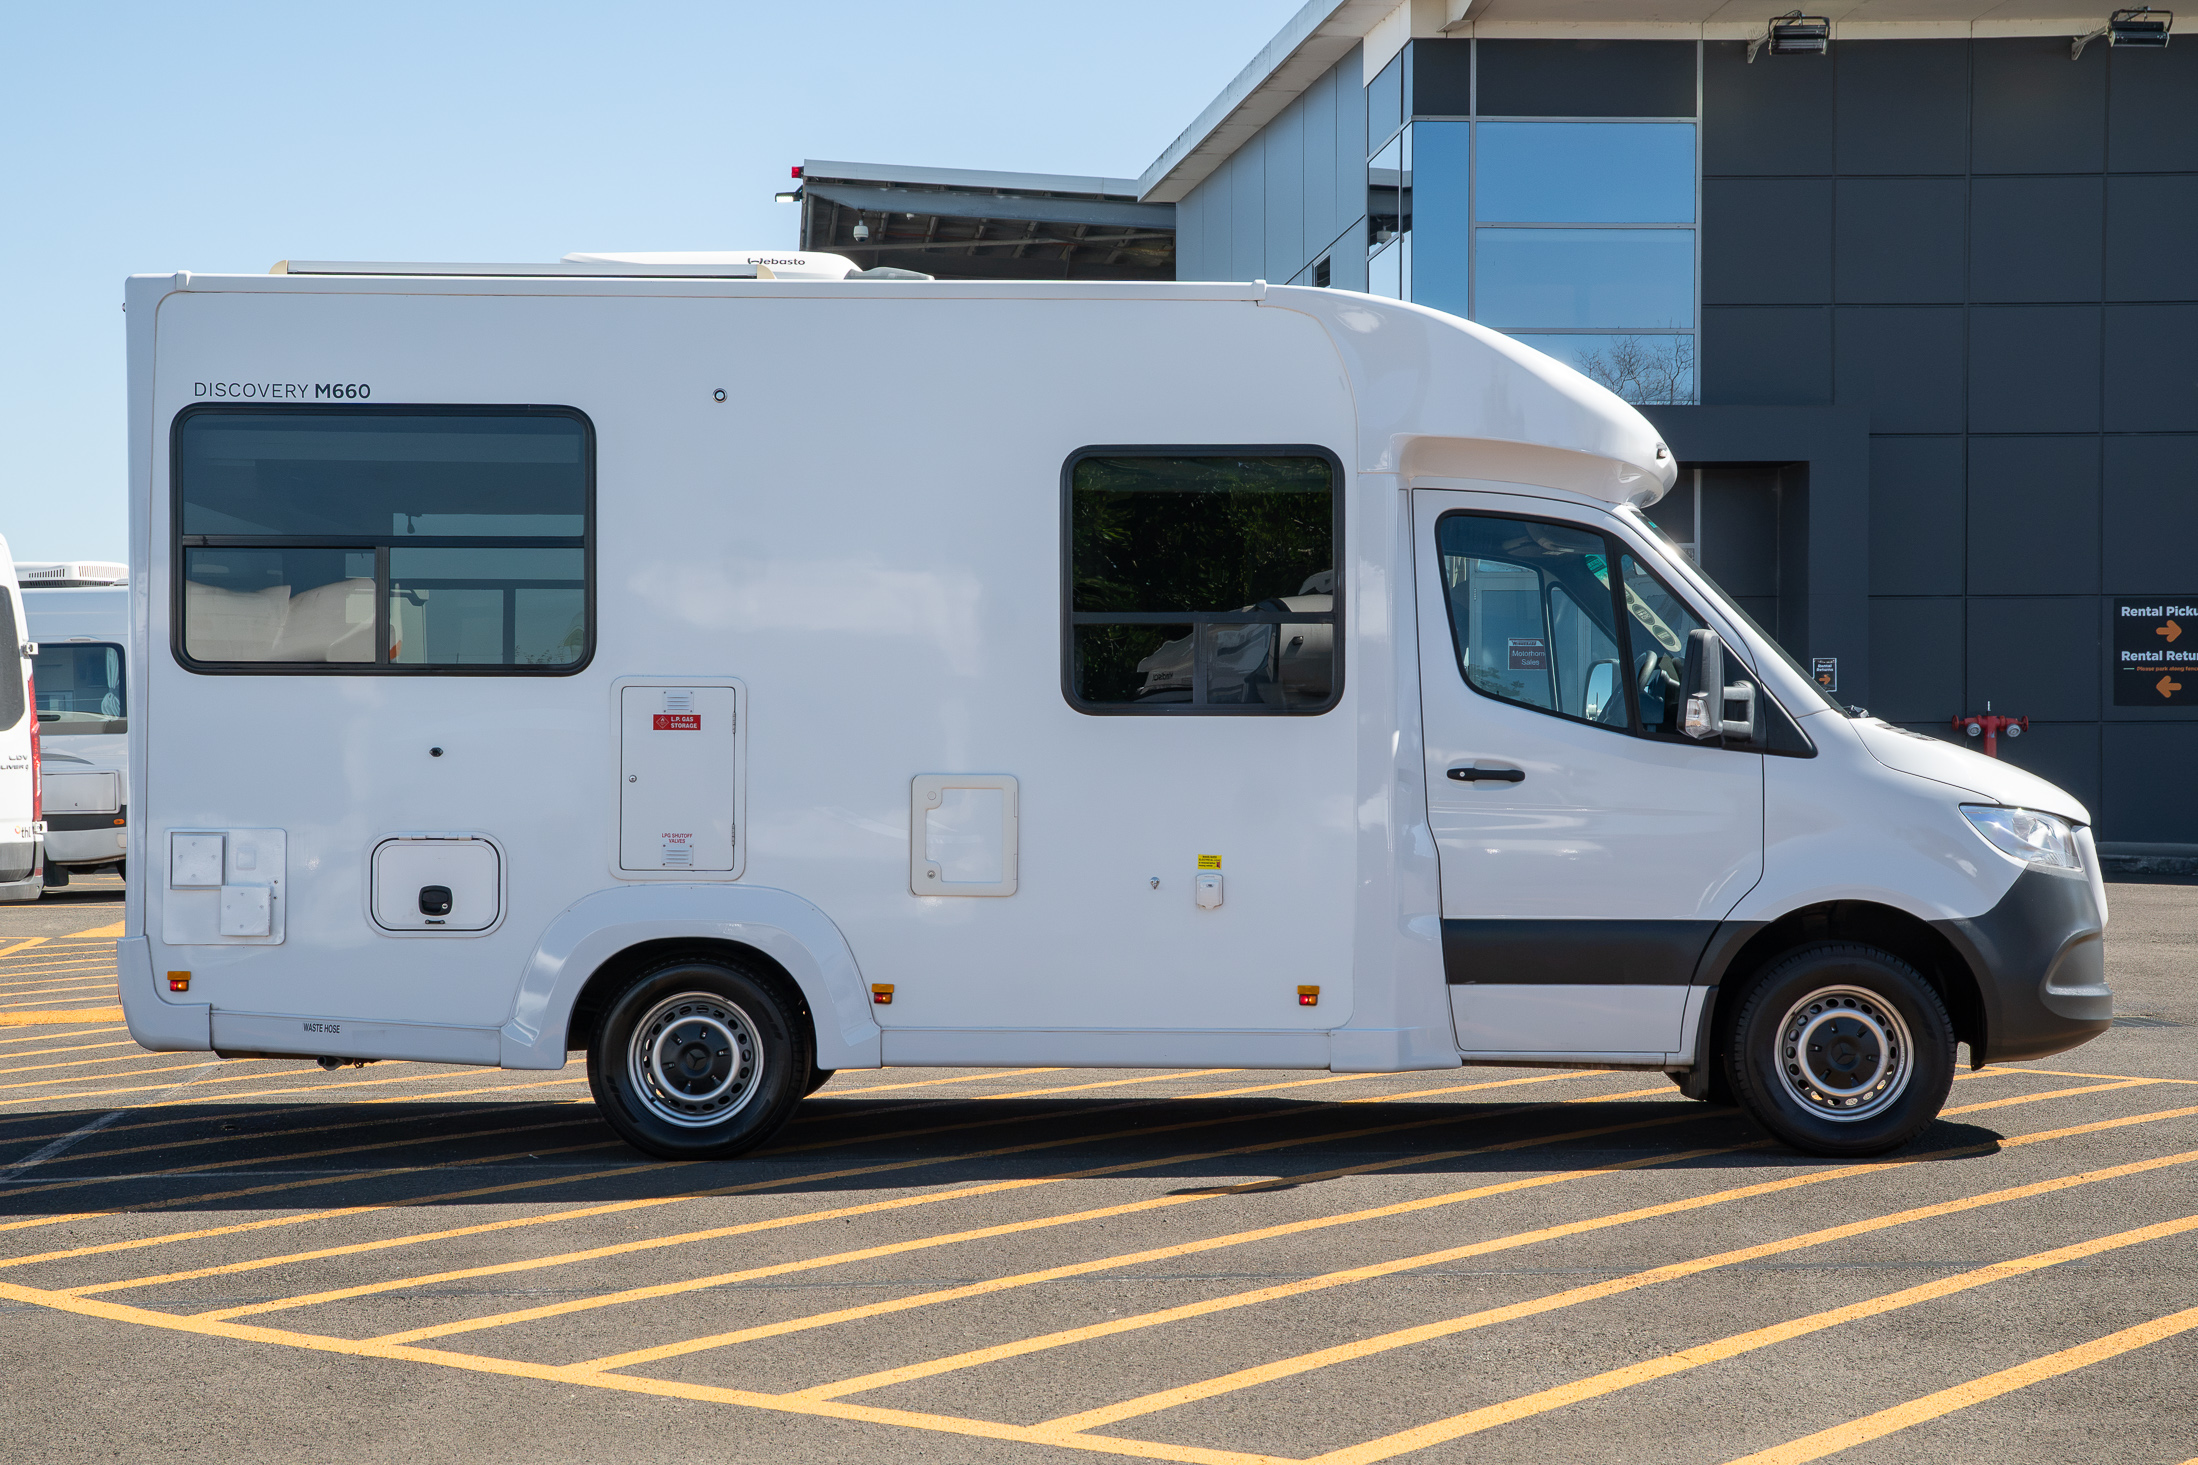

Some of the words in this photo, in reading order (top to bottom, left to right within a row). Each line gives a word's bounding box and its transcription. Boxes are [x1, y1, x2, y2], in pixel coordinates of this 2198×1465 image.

[747, 257, 806, 266] Webasto
[194, 382, 309, 398] DISCOVERY
[314, 383, 371, 399] M660
[2121, 605, 2163, 617] Rental
[2121, 650, 2163, 661] Rental
[2166, 650, 2198, 661] Retu
[1521, 658, 1540, 666] Sales
[303, 1023, 323, 1033] WASTE
[323, 1023, 341, 1034] HOSE
